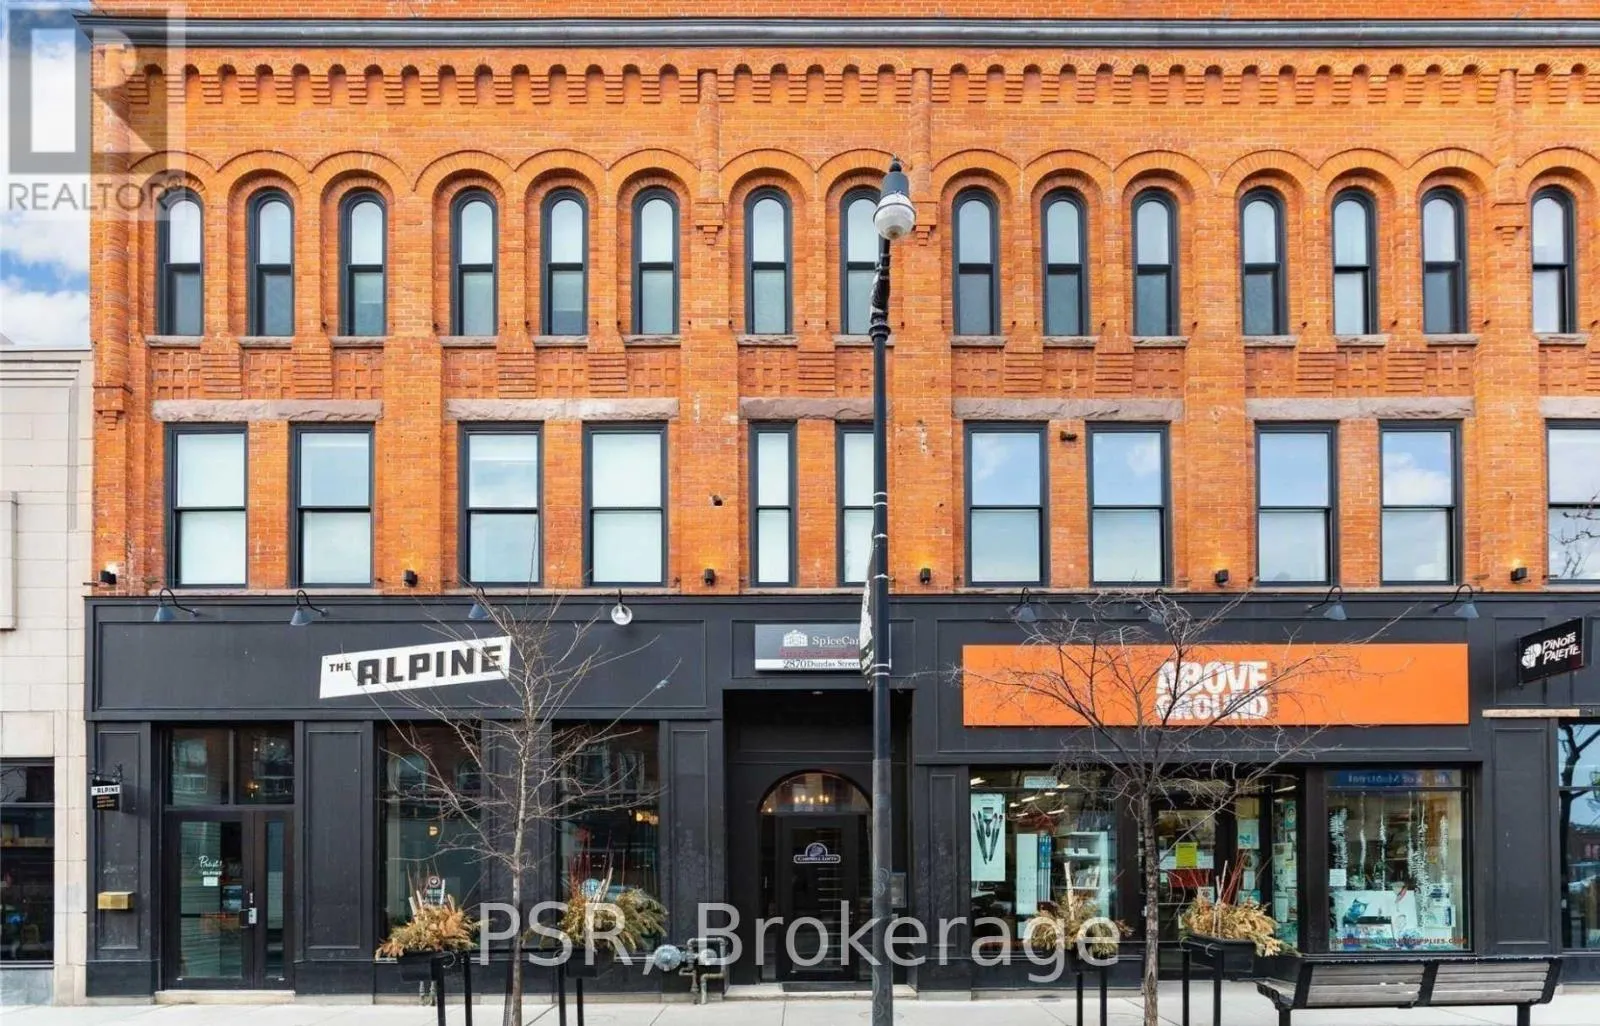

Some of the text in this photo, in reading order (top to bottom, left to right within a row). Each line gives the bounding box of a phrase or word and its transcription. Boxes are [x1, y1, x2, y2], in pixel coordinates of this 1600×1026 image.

[329, 645, 503, 686] THE ALPINE
[1543, 644, 1580, 665] PALETTE
[1155, 660, 1268, 695] ABOVE
